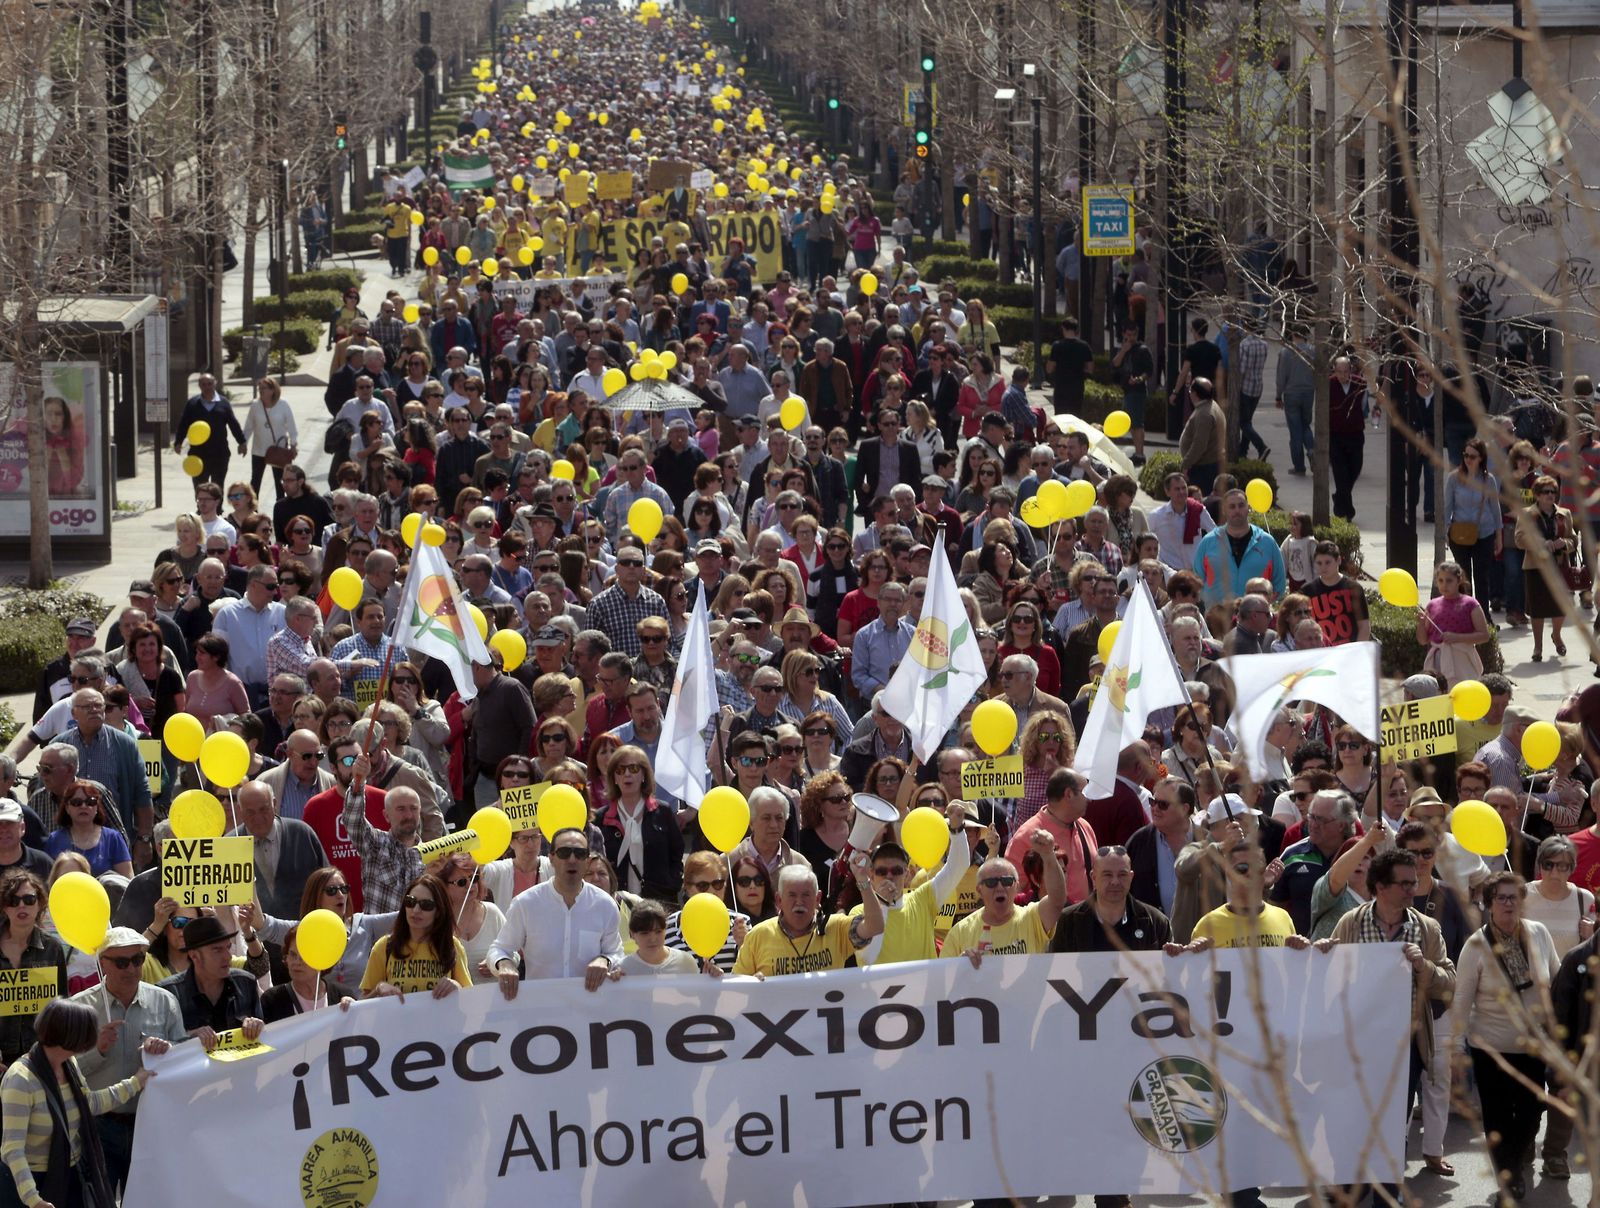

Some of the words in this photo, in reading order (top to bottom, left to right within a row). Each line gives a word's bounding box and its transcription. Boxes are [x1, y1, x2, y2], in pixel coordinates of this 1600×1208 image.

[1096, 222, 1123, 232] TAXI
[625, 215, 775, 261] SORADO
[50, 508, 97, 527] oigo
[357, 680, 378, 690] AVE
[1381, 703, 1420, 724] AVE
[1380, 717, 1455, 748] SOTERRADO
[1413, 749, 1419, 757] o
[1425, 739, 1435, 755] SÍ
[965, 760, 994, 772] AVE
[963, 772, 1022, 788] SOTERRADO
[505, 789, 532, 803] AVE
[164, 839, 213, 863] AVE
[332, 849, 358, 858] SWIT
[164, 863, 252, 887] SOTERRADO
[184, 886, 195, 905] SÍ
[203, 894, 209, 904] o
[217, 885, 228, 903] SÍ
[0, 970, 29, 985] AVE
[408, 960, 444, 978] SOTERRA
[0, 984, 56, 1002] SOTERRADO
[217, 1031, 233, 1047] VE
[292, 985, 1000, 1131] ¡Reconexión
[1046, 971, 1234, 1041] Ya!
[1145, 1069, 1182, 1149] GRANADA
[497, 1110, 706, 1177] Ahora
[734, 1094, 790, 1157] el
[815, 1089, 971, 1150] Tren
[332, 1130, 377, 1180] AMARILLA
[303, 1144, 325, 1200] MAREA
